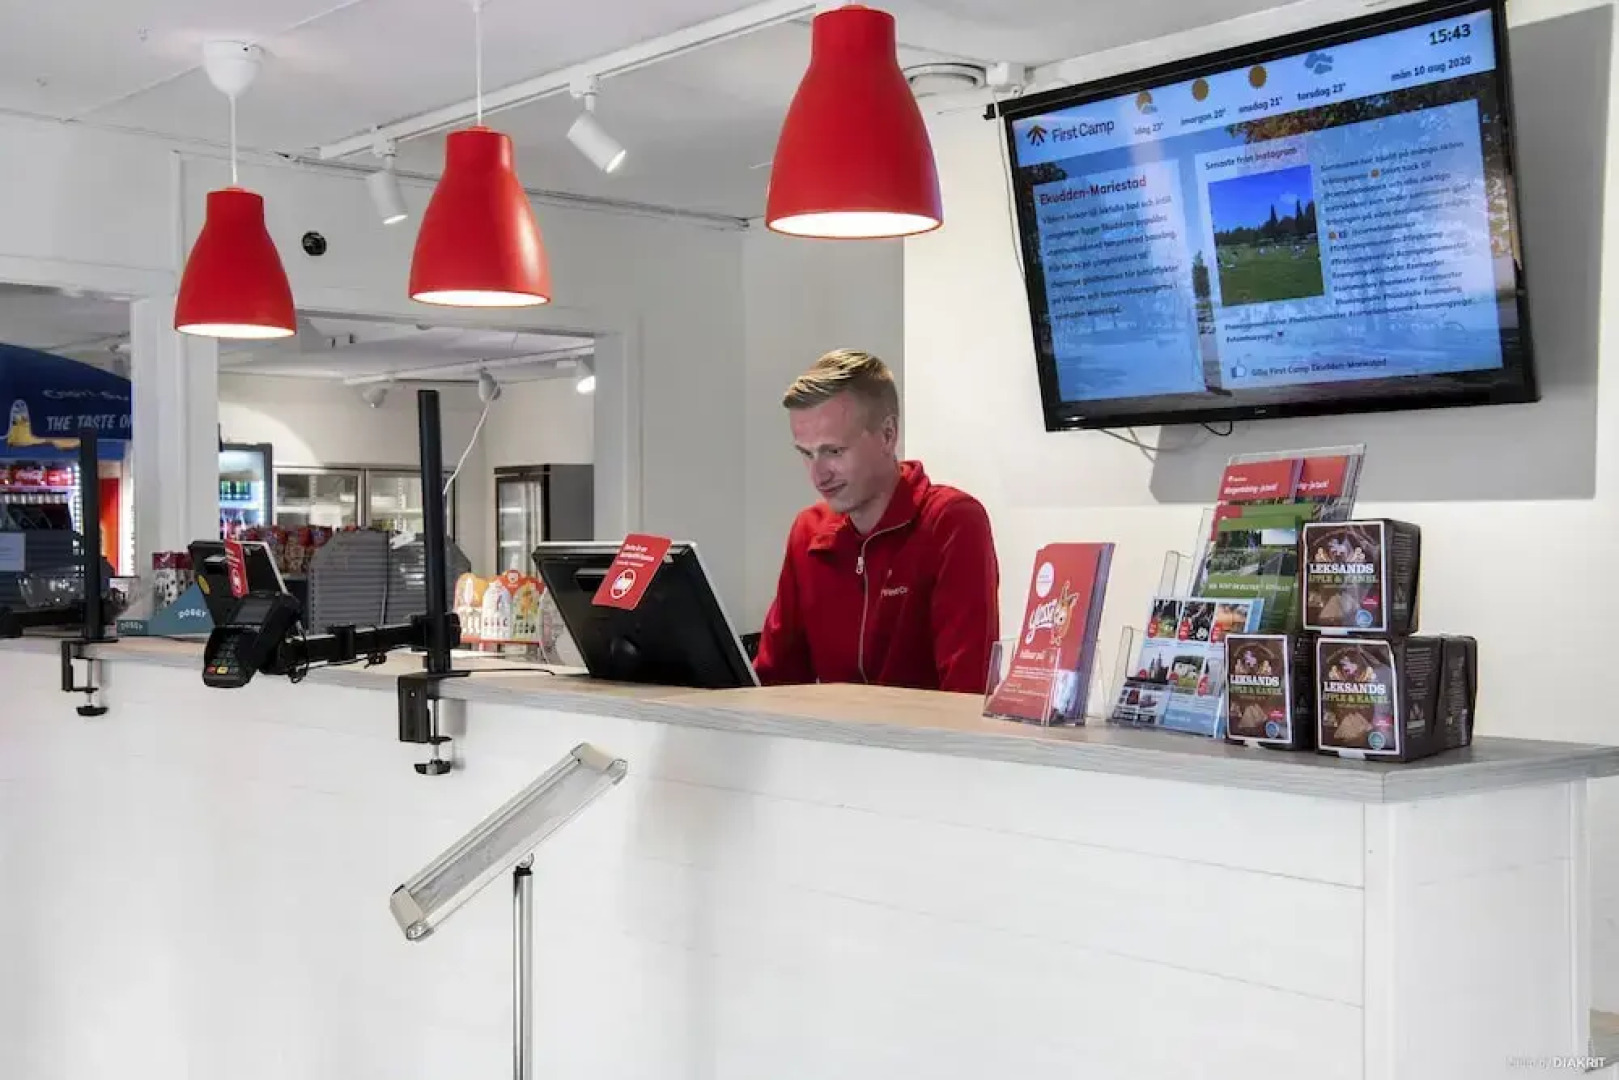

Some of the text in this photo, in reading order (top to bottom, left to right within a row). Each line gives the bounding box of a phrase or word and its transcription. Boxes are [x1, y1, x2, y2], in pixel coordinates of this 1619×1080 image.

[1429, 24, 1471, 45] 15:43
[1414, 65, 1425, 76] 10
[1427, 63, 1446, 73] aug
[1448, 55, 1472, 68] 2020
[1051, 119, 1115, 143] First Camp
[1040, 175, 1147, 205] Ekudden-Mariestad
[46, 415, 73, 430] THE
[77, 413, 116, 429] TASTE
[1310, 562, 1374, 574] LEKSANDS
[1323, 681, 1387, 695] LEKSANDS
